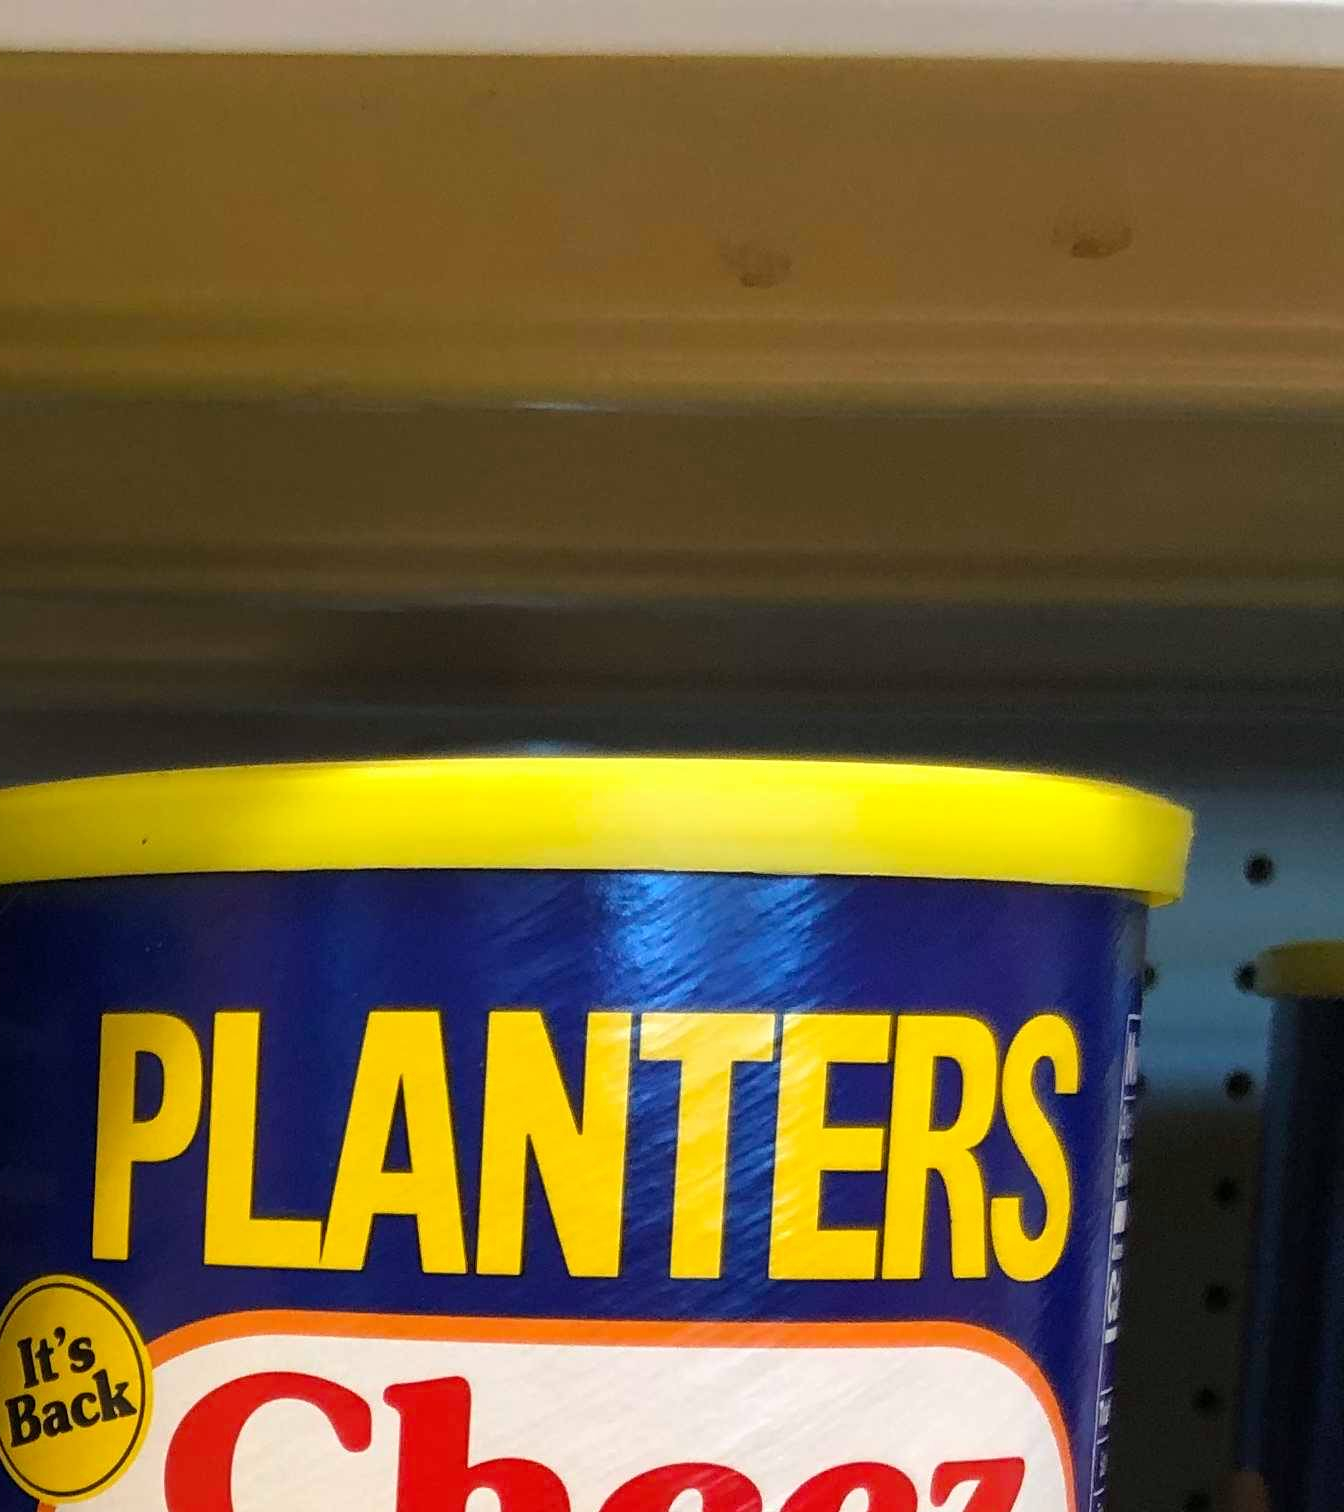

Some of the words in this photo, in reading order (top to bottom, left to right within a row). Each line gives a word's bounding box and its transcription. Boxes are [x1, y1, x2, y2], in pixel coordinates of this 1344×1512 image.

[92, 1009, 1082, 1282] PLANTERS
[17, 1327, 95, 1389] It's
[5, 1370, 137, 1448] Back
